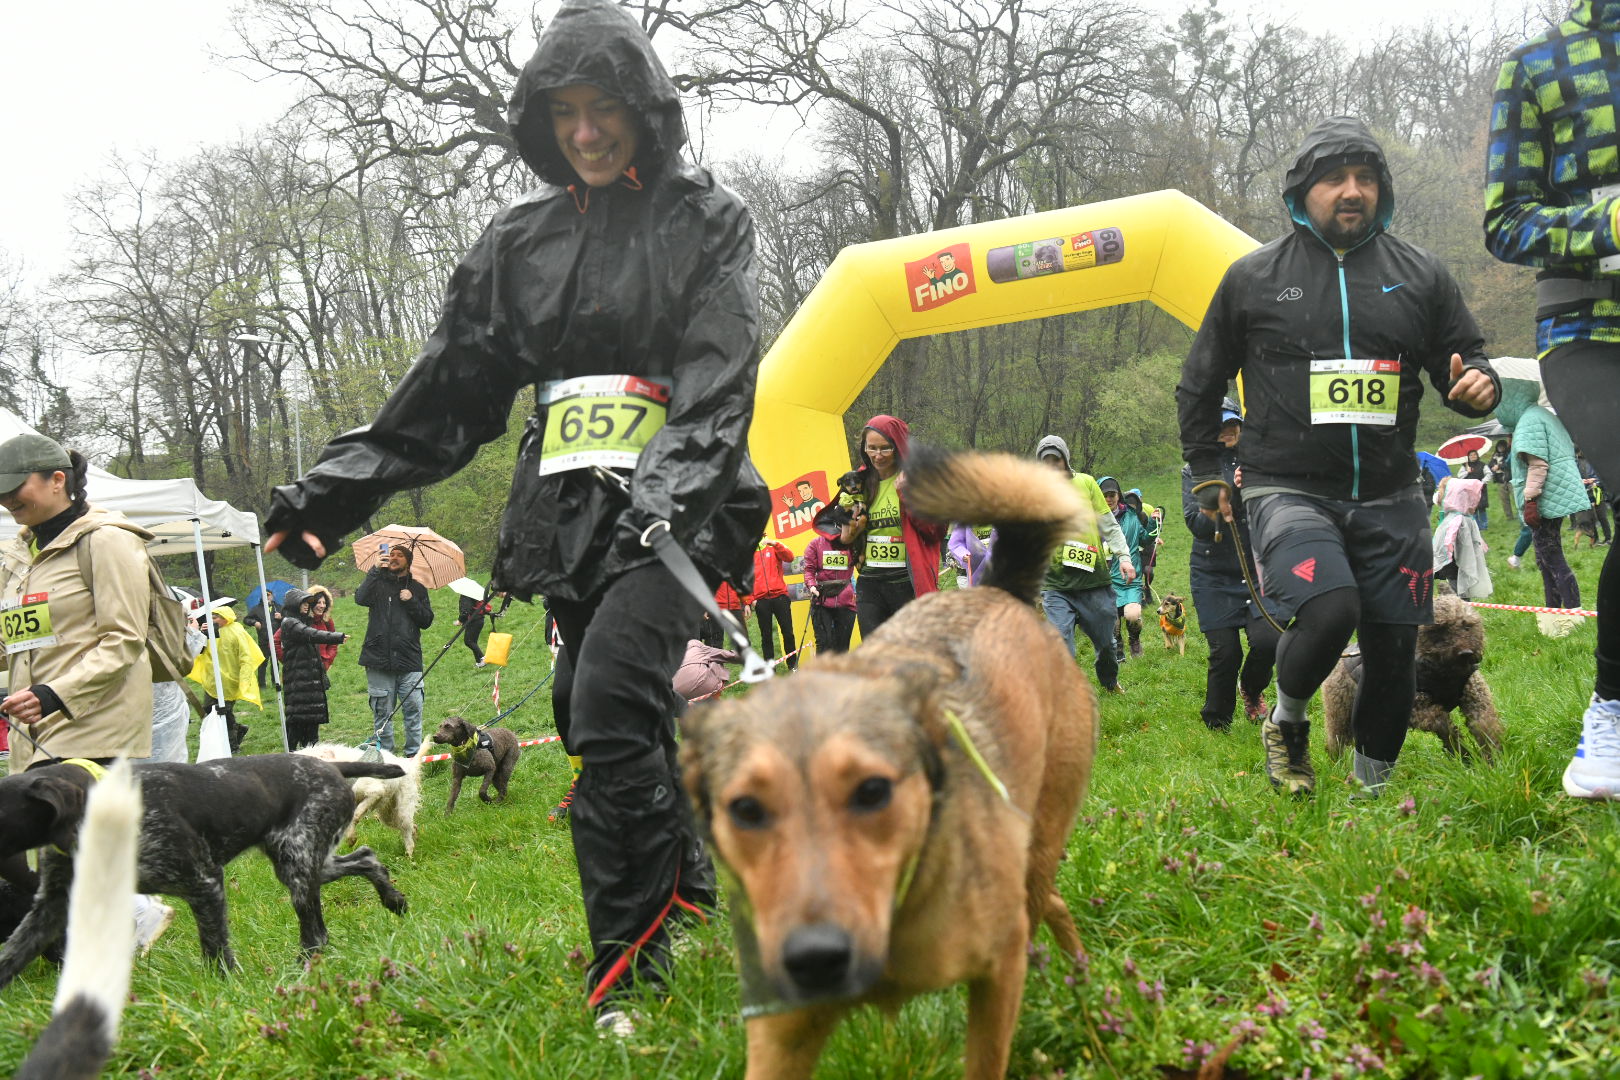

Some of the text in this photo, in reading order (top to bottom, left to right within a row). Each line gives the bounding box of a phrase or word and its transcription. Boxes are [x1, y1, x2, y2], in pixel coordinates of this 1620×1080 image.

[1073, 239, 1092, 250] FINO
[914, 272, 969, 308] FINO
[1328, 378, 1386, 405] 618
[560, 403, 648, 443] 657
[826, 556, 845, 565] 643
[871, 545, 900, 559] 639
[1068, 548, 1092, 564] 638
[4, 609, 40, 638] 625
